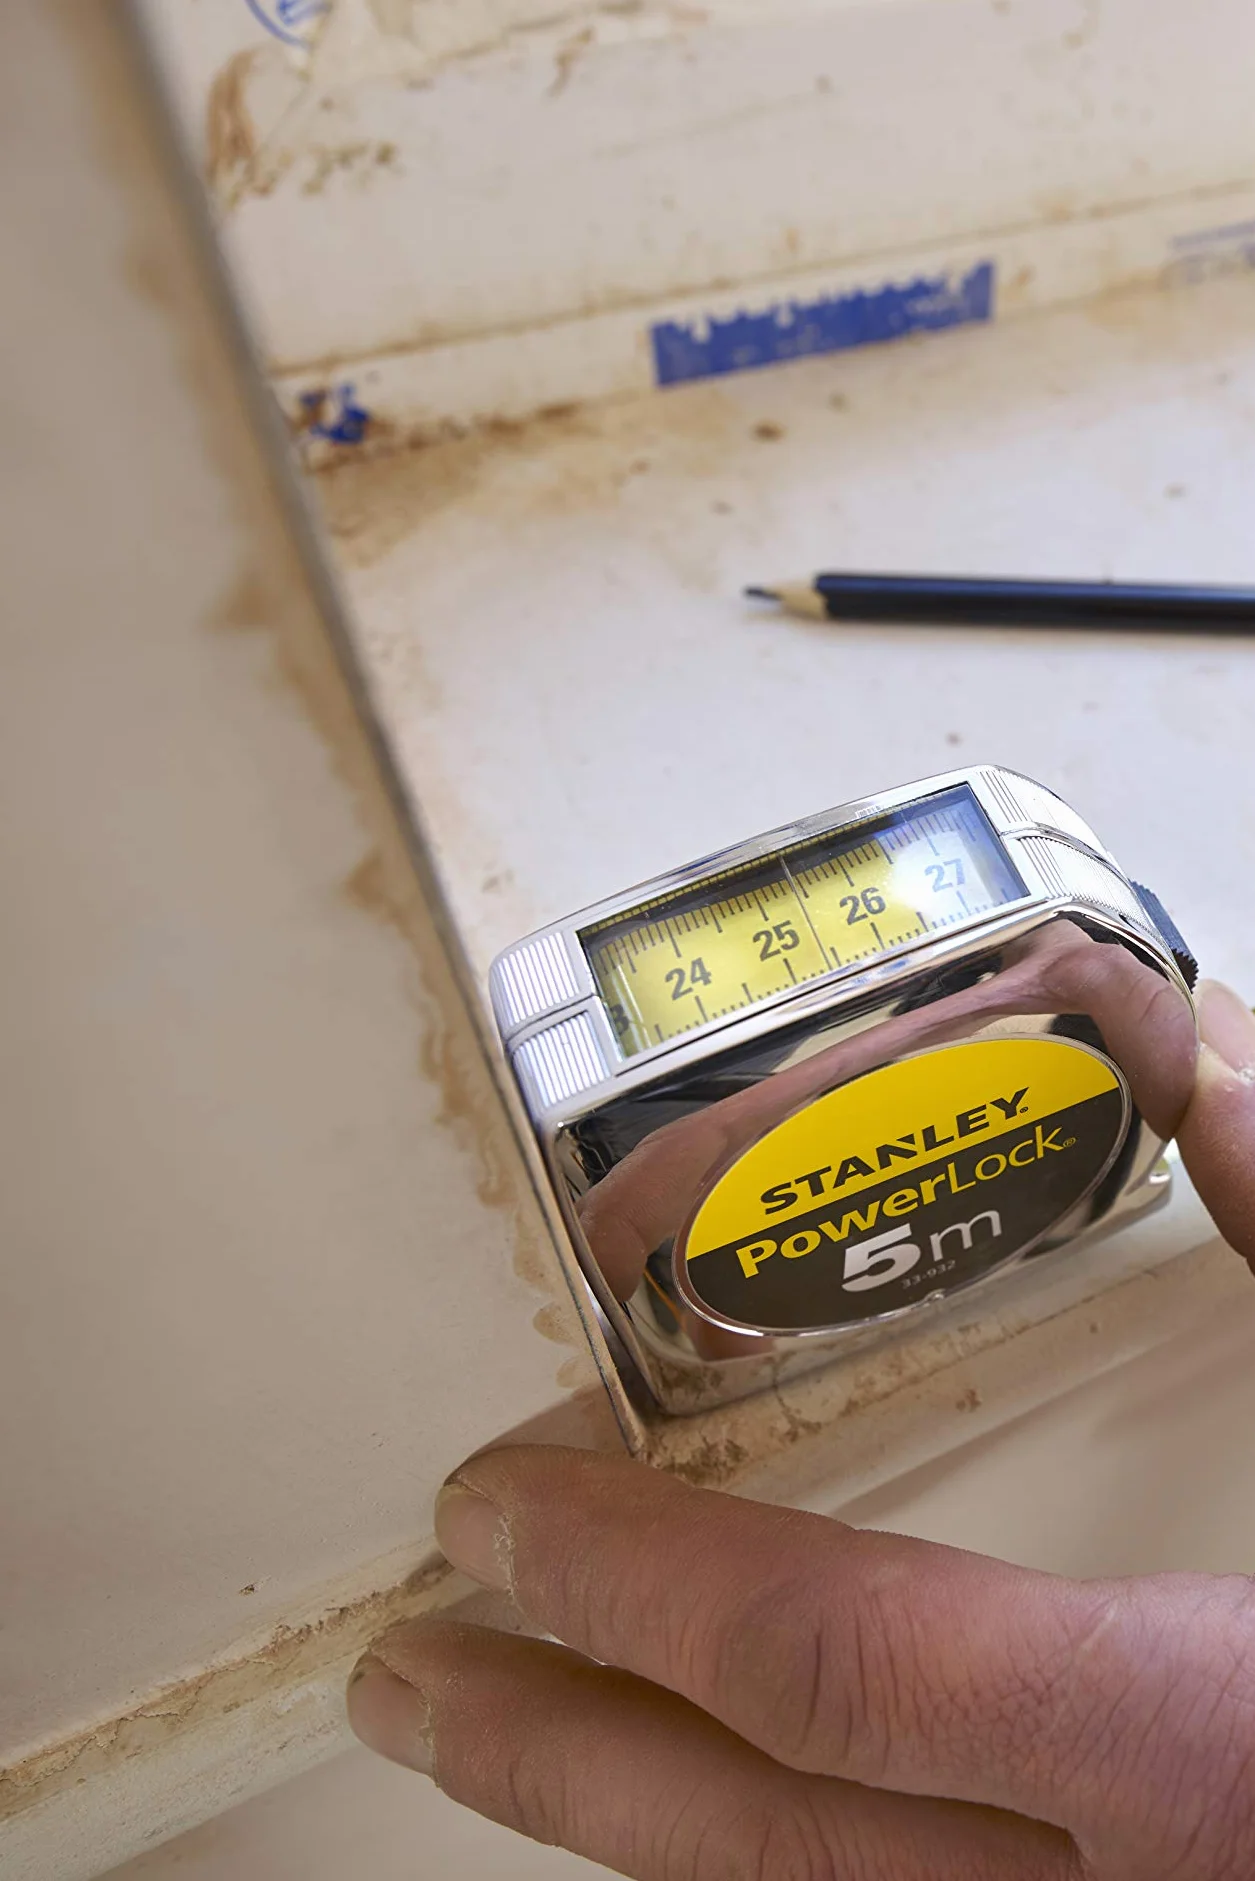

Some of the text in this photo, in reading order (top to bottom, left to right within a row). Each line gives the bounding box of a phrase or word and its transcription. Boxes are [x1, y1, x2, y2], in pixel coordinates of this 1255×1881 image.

[664, 957, 712, 1001] 24
[752, 920, 800, 961] 25
[839, 886, 886, 925] 26
[924, 857, 964, 893] 27
[736, 1125, 1065, 1279] PowerLock
[760, 1087, 1030, 1214] STANLEY
